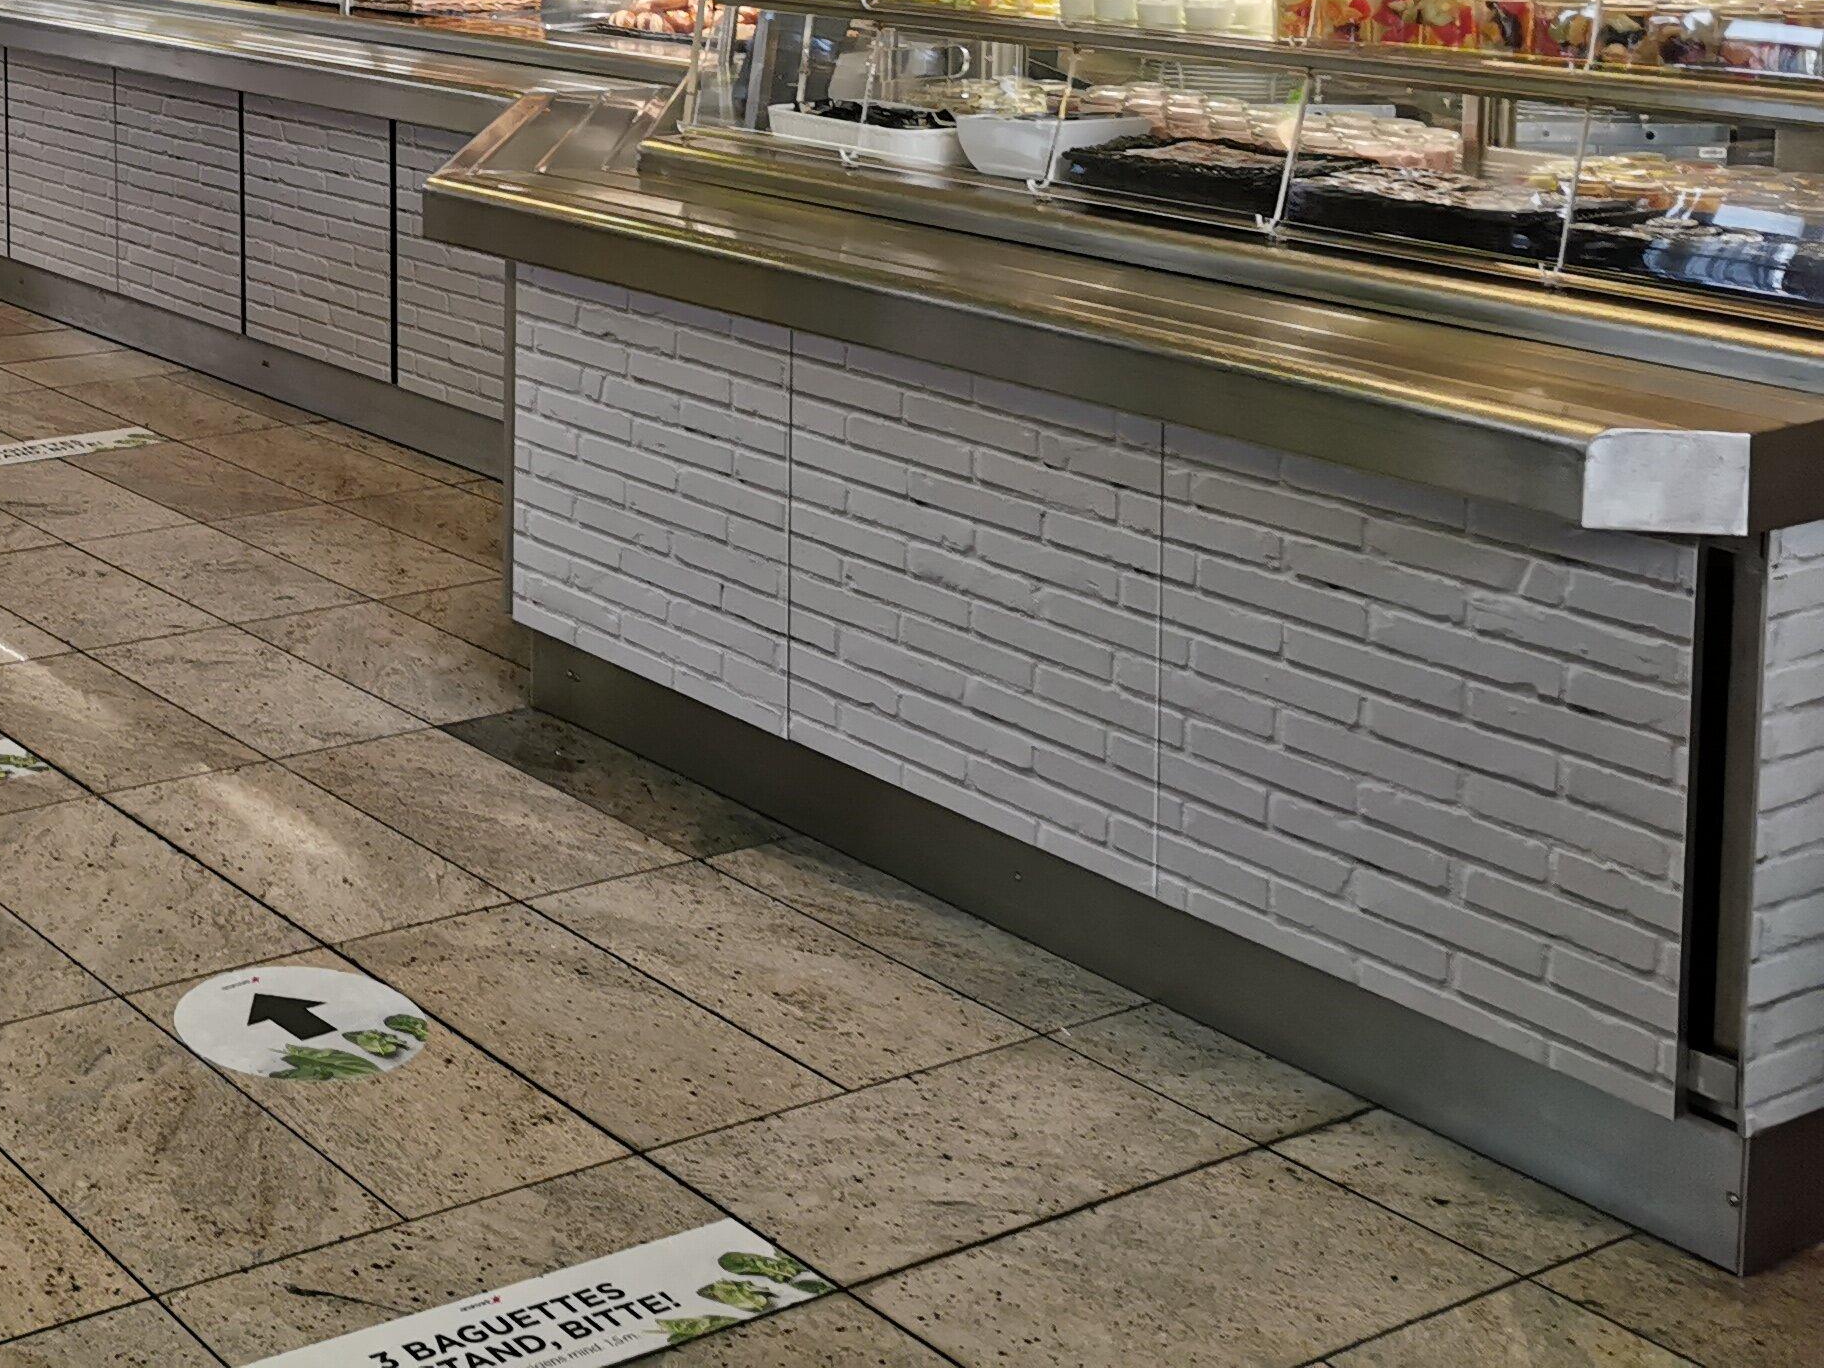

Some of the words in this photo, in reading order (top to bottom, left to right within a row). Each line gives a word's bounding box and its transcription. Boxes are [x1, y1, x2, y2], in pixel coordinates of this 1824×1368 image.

[369, 1351, 399, 1368] 3
[402, 1282, 626, 1361] BAGUETTES
[419, 1335, 562, 1368] TAND,
[557, 1291, 682, 1340] BITTE!
